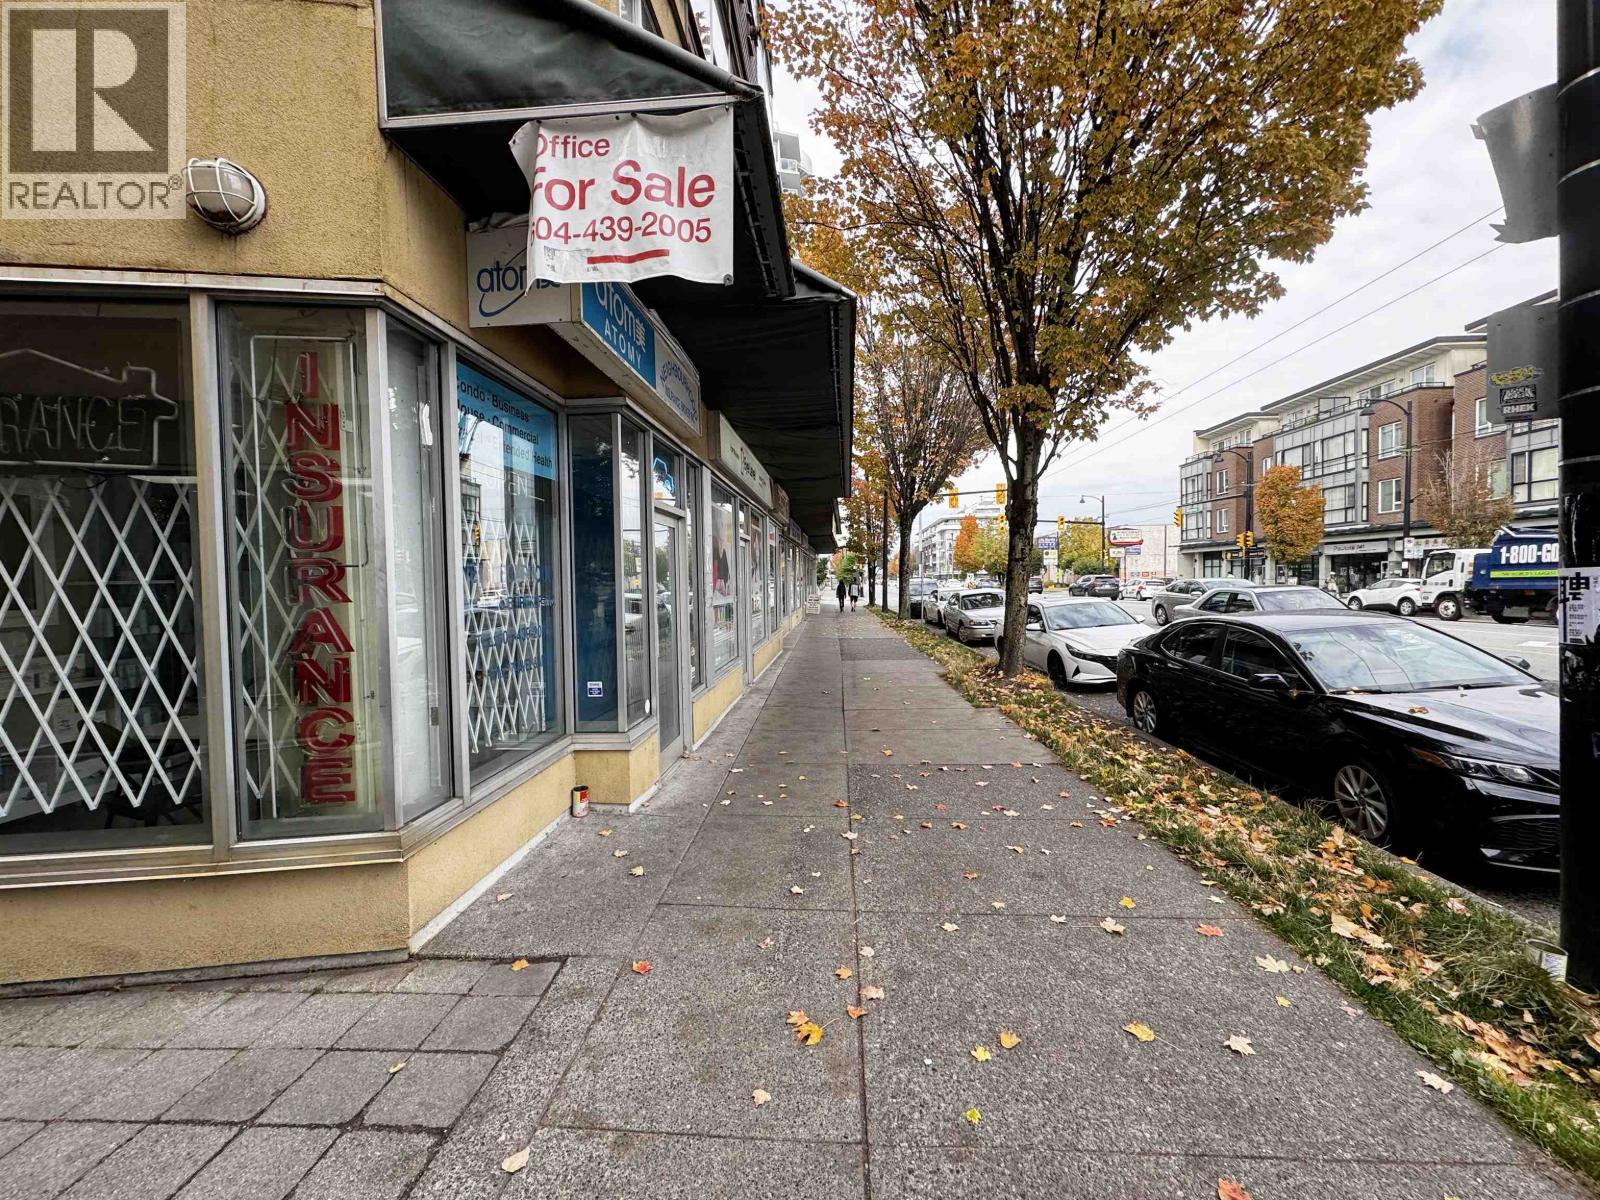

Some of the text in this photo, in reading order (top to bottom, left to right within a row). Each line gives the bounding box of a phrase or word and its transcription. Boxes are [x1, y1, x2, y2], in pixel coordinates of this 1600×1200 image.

[611, 160, 715, 209] Sale
[604, 319, 641, 370] ATOMY
[492, 394, 529, 423] Business
[1503, 403, 1536, 414] RHEK
[492, 415, 539, 446] Commercial
[531, 449, 553, 469] Health
[280, 351, 356, 804] INSURANCE
